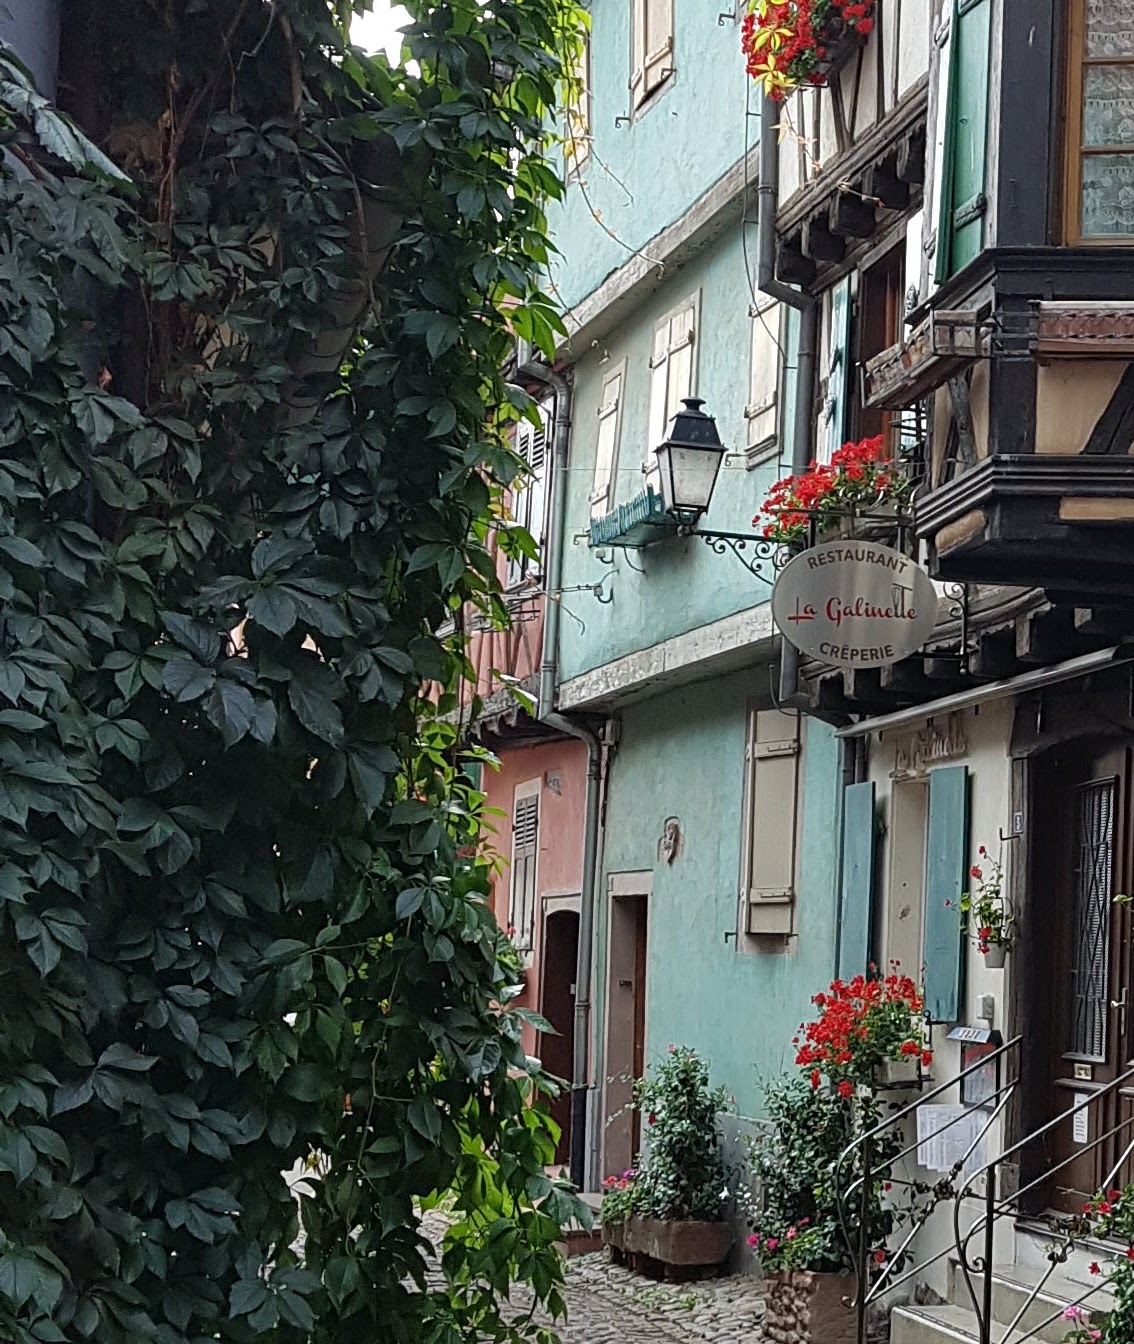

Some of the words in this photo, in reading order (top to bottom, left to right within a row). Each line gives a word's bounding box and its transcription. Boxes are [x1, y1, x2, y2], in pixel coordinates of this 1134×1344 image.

[807, 549, 908, 574] RESTAURANT
[787, 597, 818, 626] La
[825, 582, 918, 627] Galinette
[819, 642, 895, 662] CRÊPERIE
